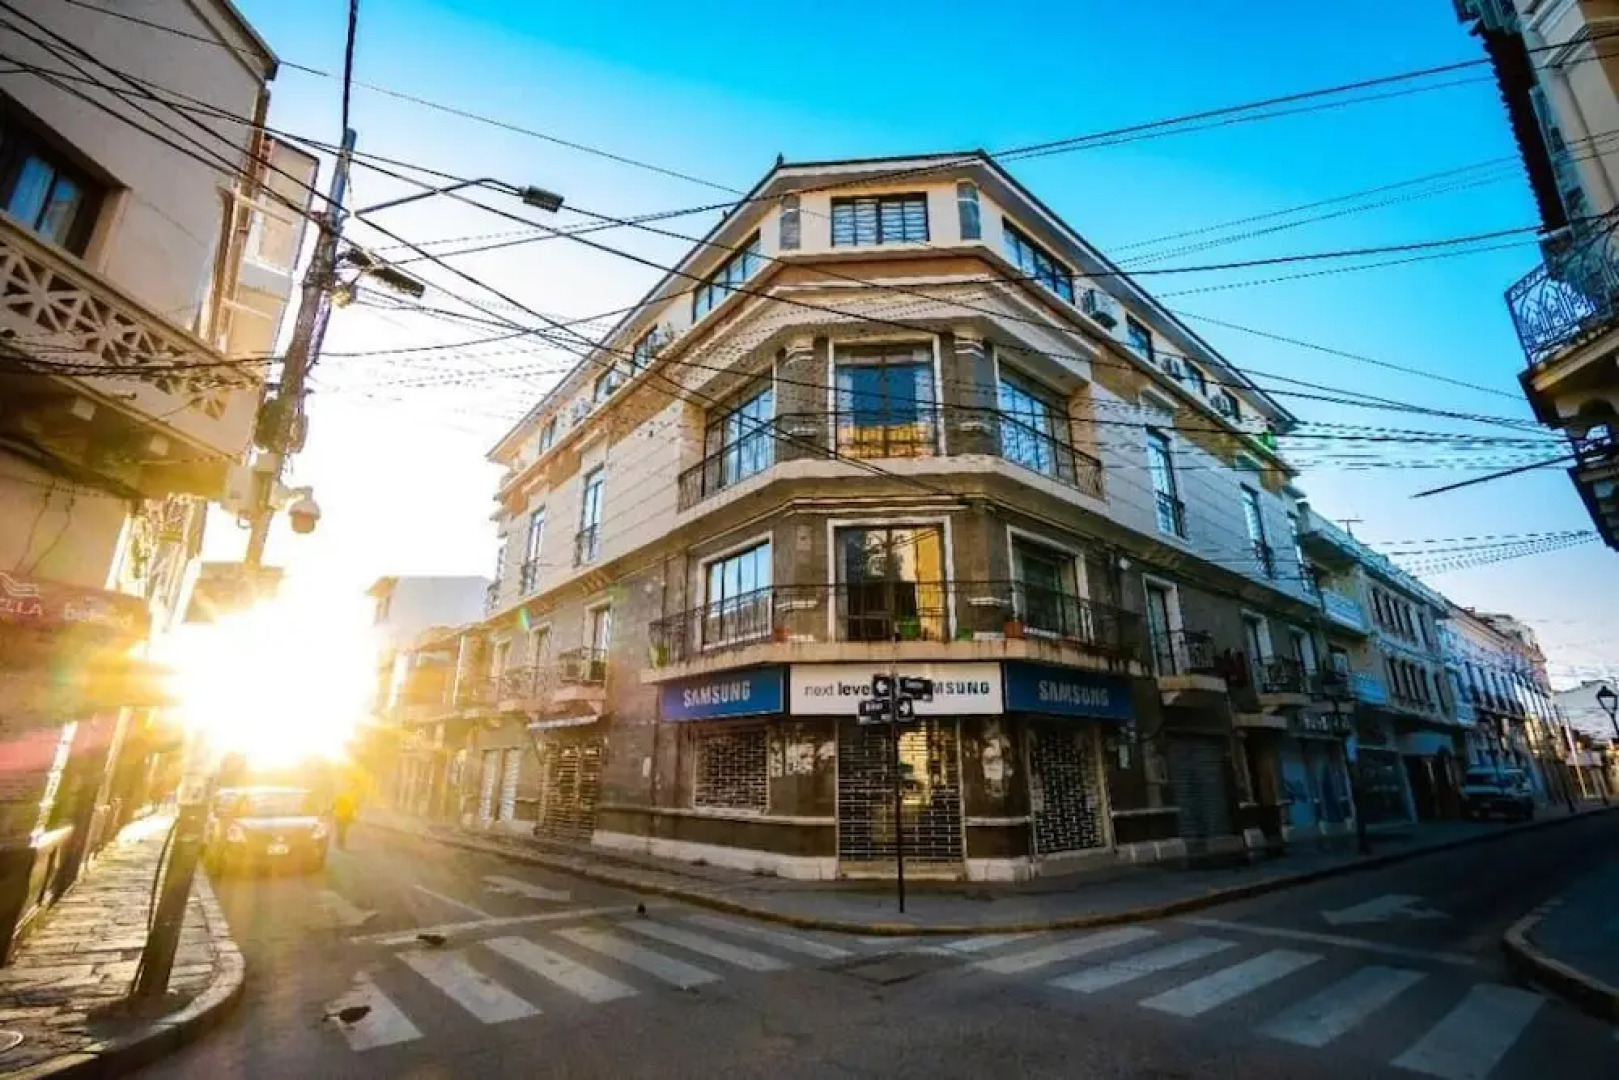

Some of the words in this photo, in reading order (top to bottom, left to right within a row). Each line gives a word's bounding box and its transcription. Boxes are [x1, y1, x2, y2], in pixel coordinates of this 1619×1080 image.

[683, 680, 751, 708] SAMSUNG
[804, 685, 834, 697] next
[838, 681, 872, 697] leve
[932, 681, 990, 695] MSUNG
[1038, 679, 1110, 707] SAMSUNG
